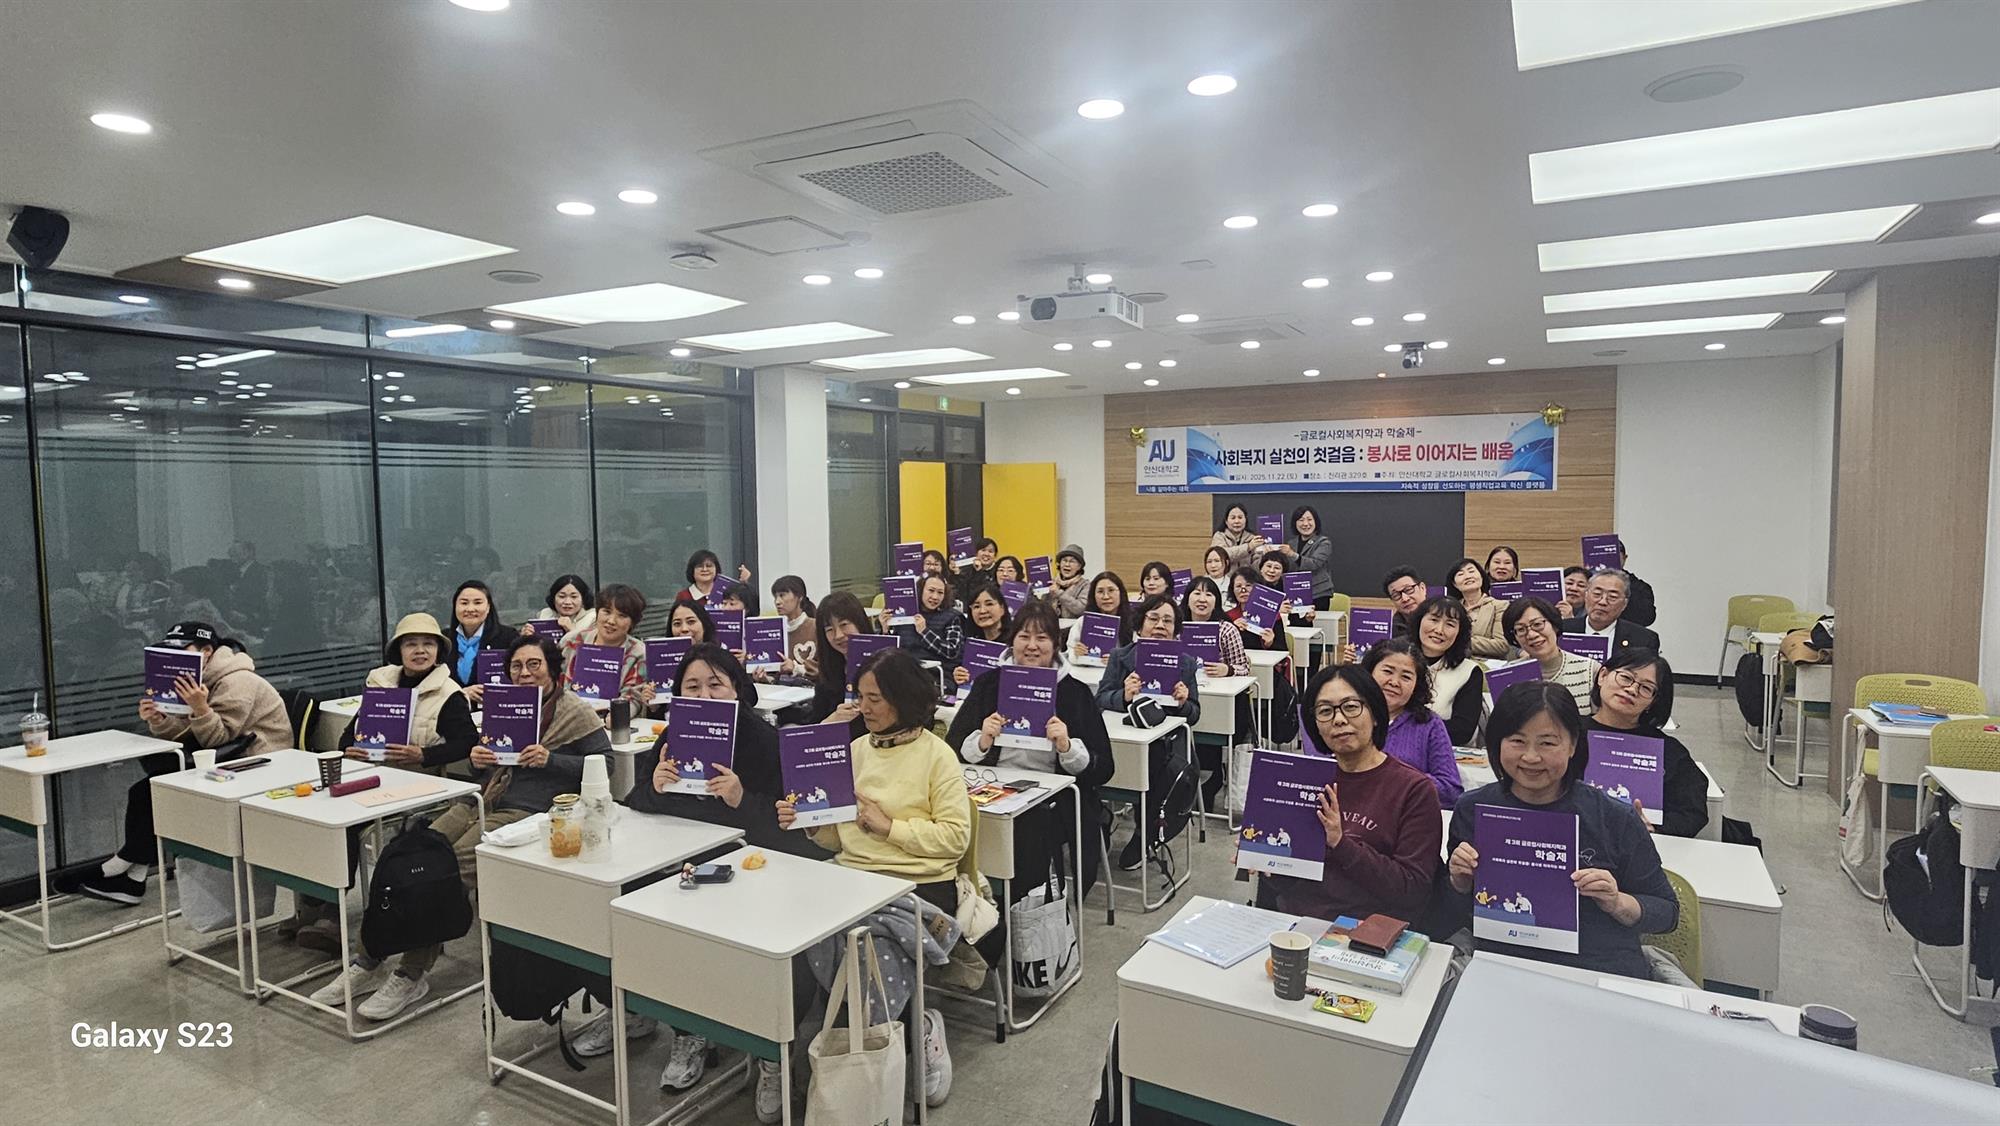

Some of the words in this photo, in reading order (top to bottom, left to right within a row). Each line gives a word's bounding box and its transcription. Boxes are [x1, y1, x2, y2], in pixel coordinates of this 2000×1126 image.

[1149, 440, 1175, 462] AU
[1215, 448, 1266, 466] 사회복지
[1269, 446, 1309, 465] 실천의
[1313, 445, 1356, 464] 첫걸음
[1367, 444, 1412, 463] 봉사로
[1416, 443, 1477, 462] 이어지는
[1481, 441, 1514, 461] 배움
[1442, 482, 1467, 490] 선도하는
[1510, 481, 1523, 489] 혁신
[1342, 811, 1378, 831] VEAU
[1535, 849, 1567, 863] 학술제
[1011, 959, 1049, 988] IKE
